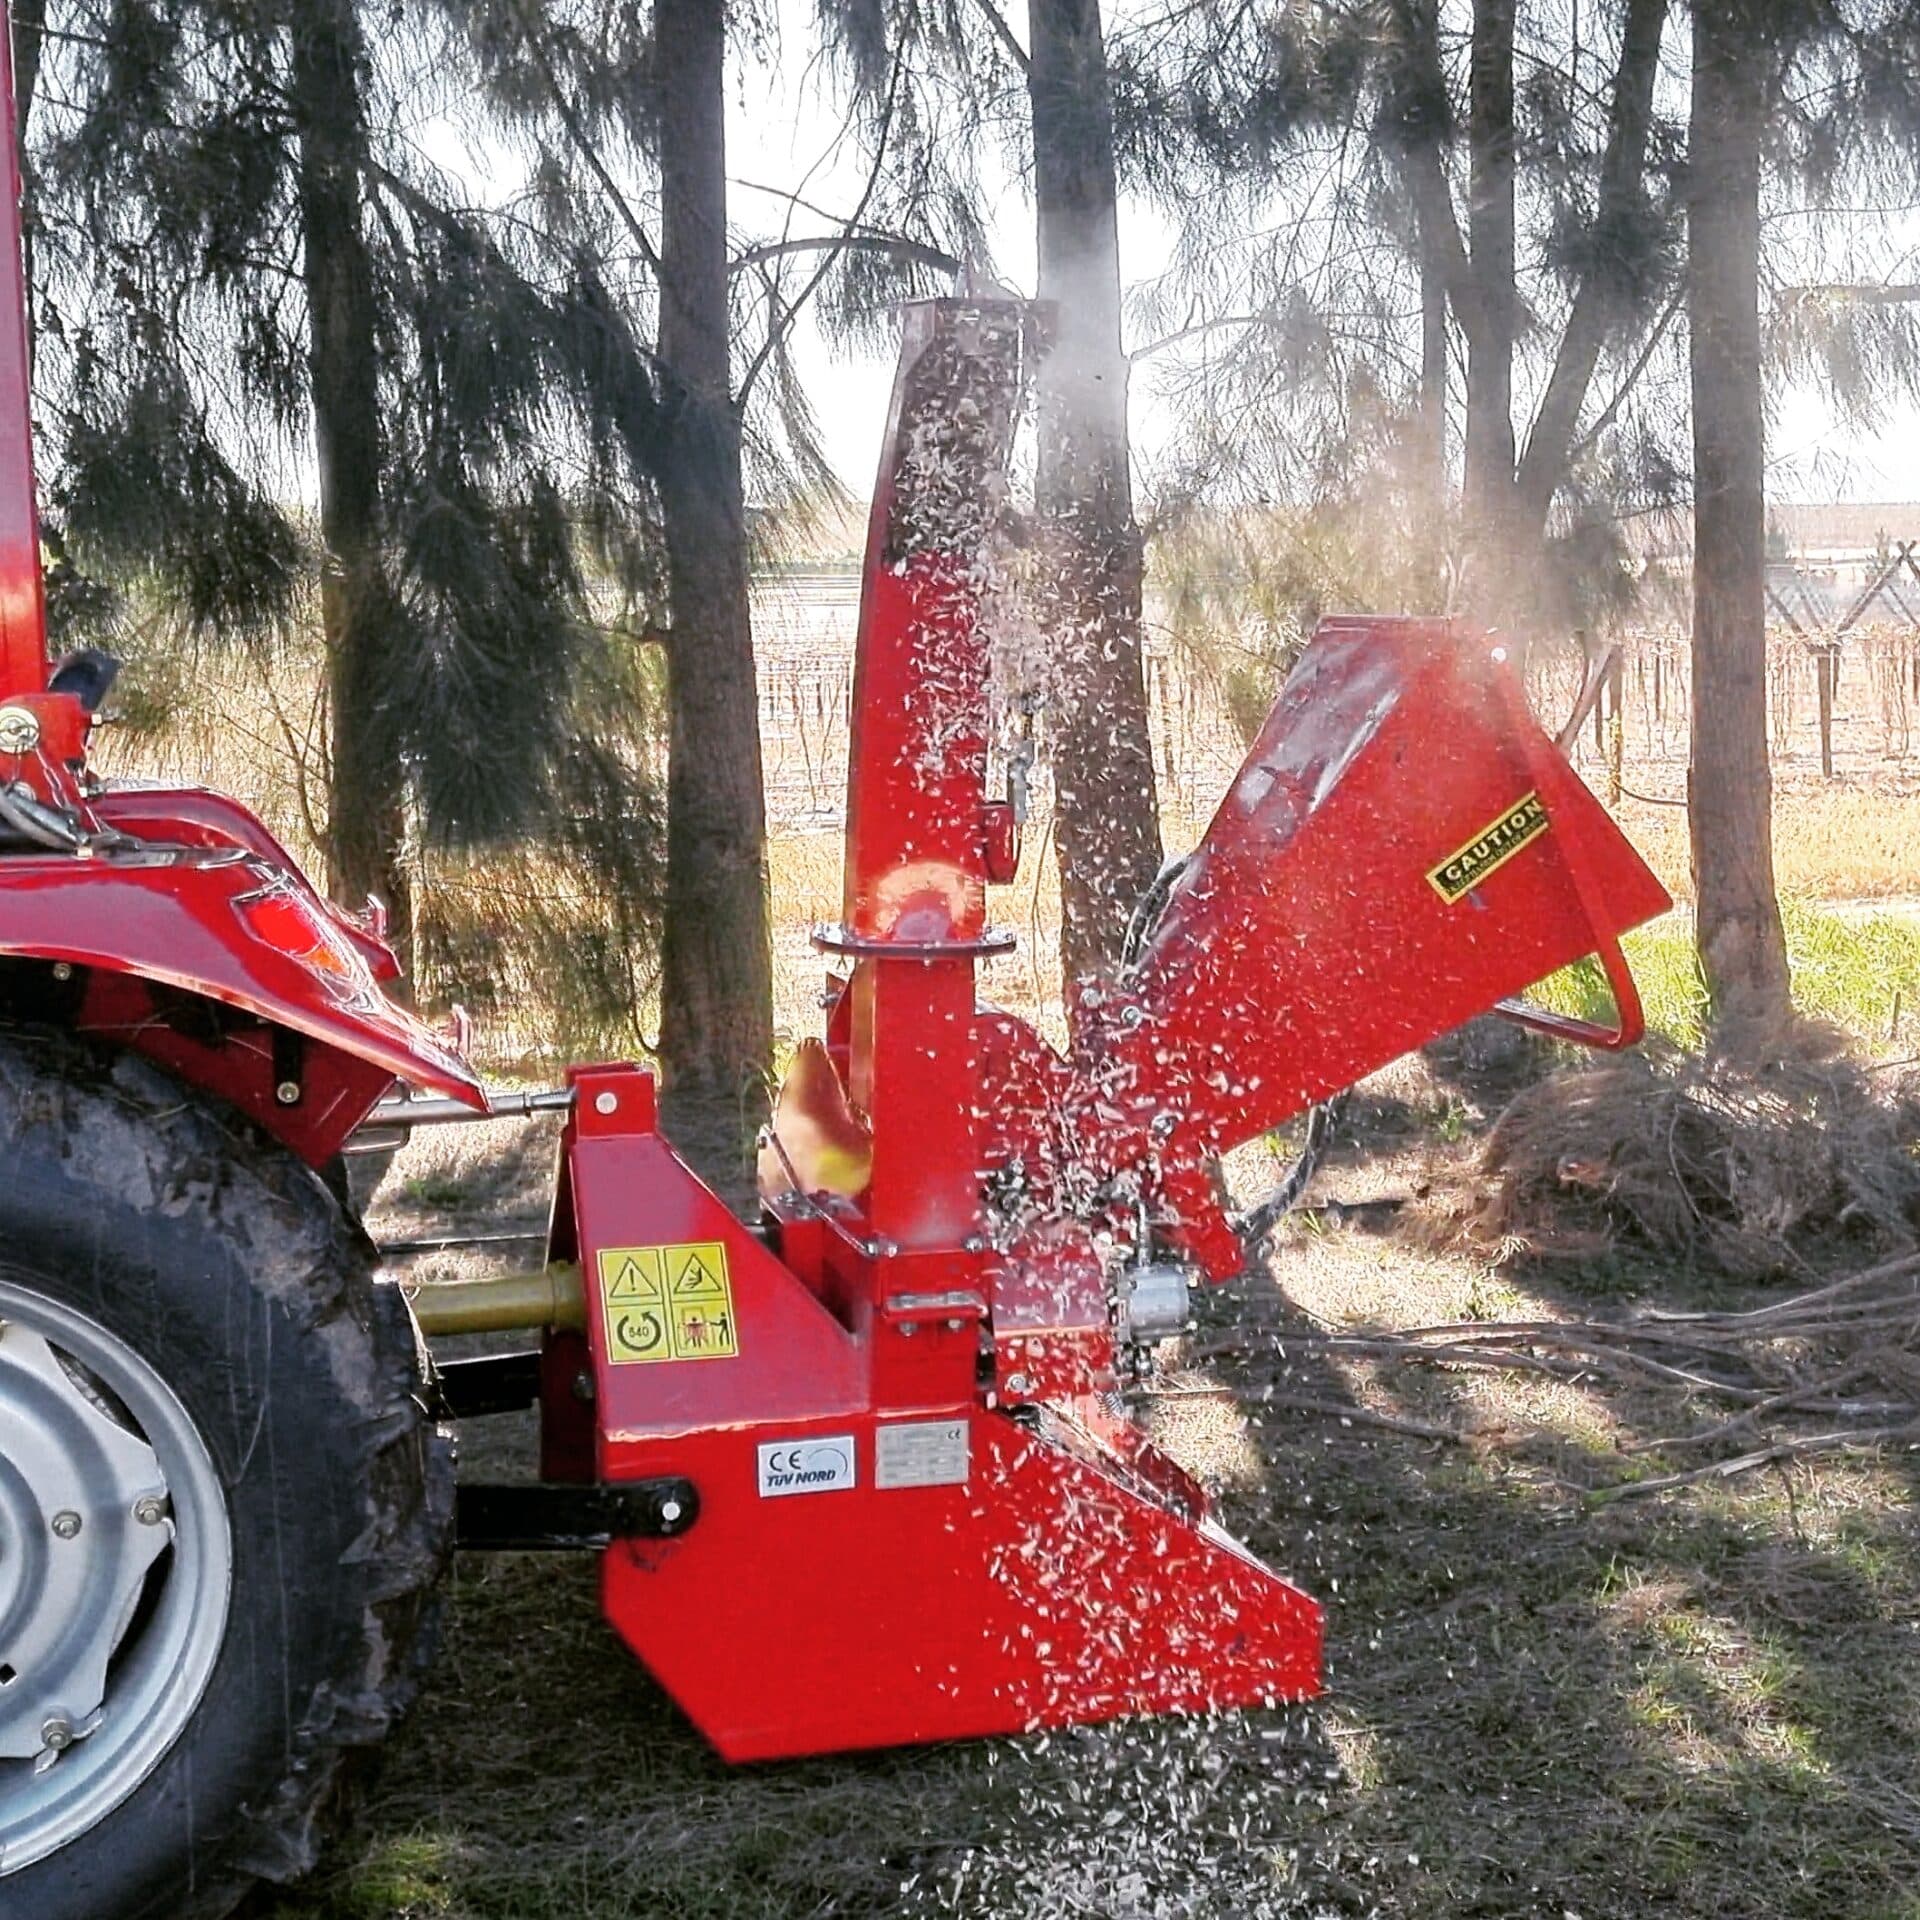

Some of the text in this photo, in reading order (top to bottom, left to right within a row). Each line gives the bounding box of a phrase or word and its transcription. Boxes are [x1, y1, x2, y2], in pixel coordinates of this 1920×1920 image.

[1445, 799, 1543, 881] CAUTION
[628, 1326, 650, 1338] 540
[769, 1449, 802, 1472] CE
[795, 1469, 836, 1485] NORD
